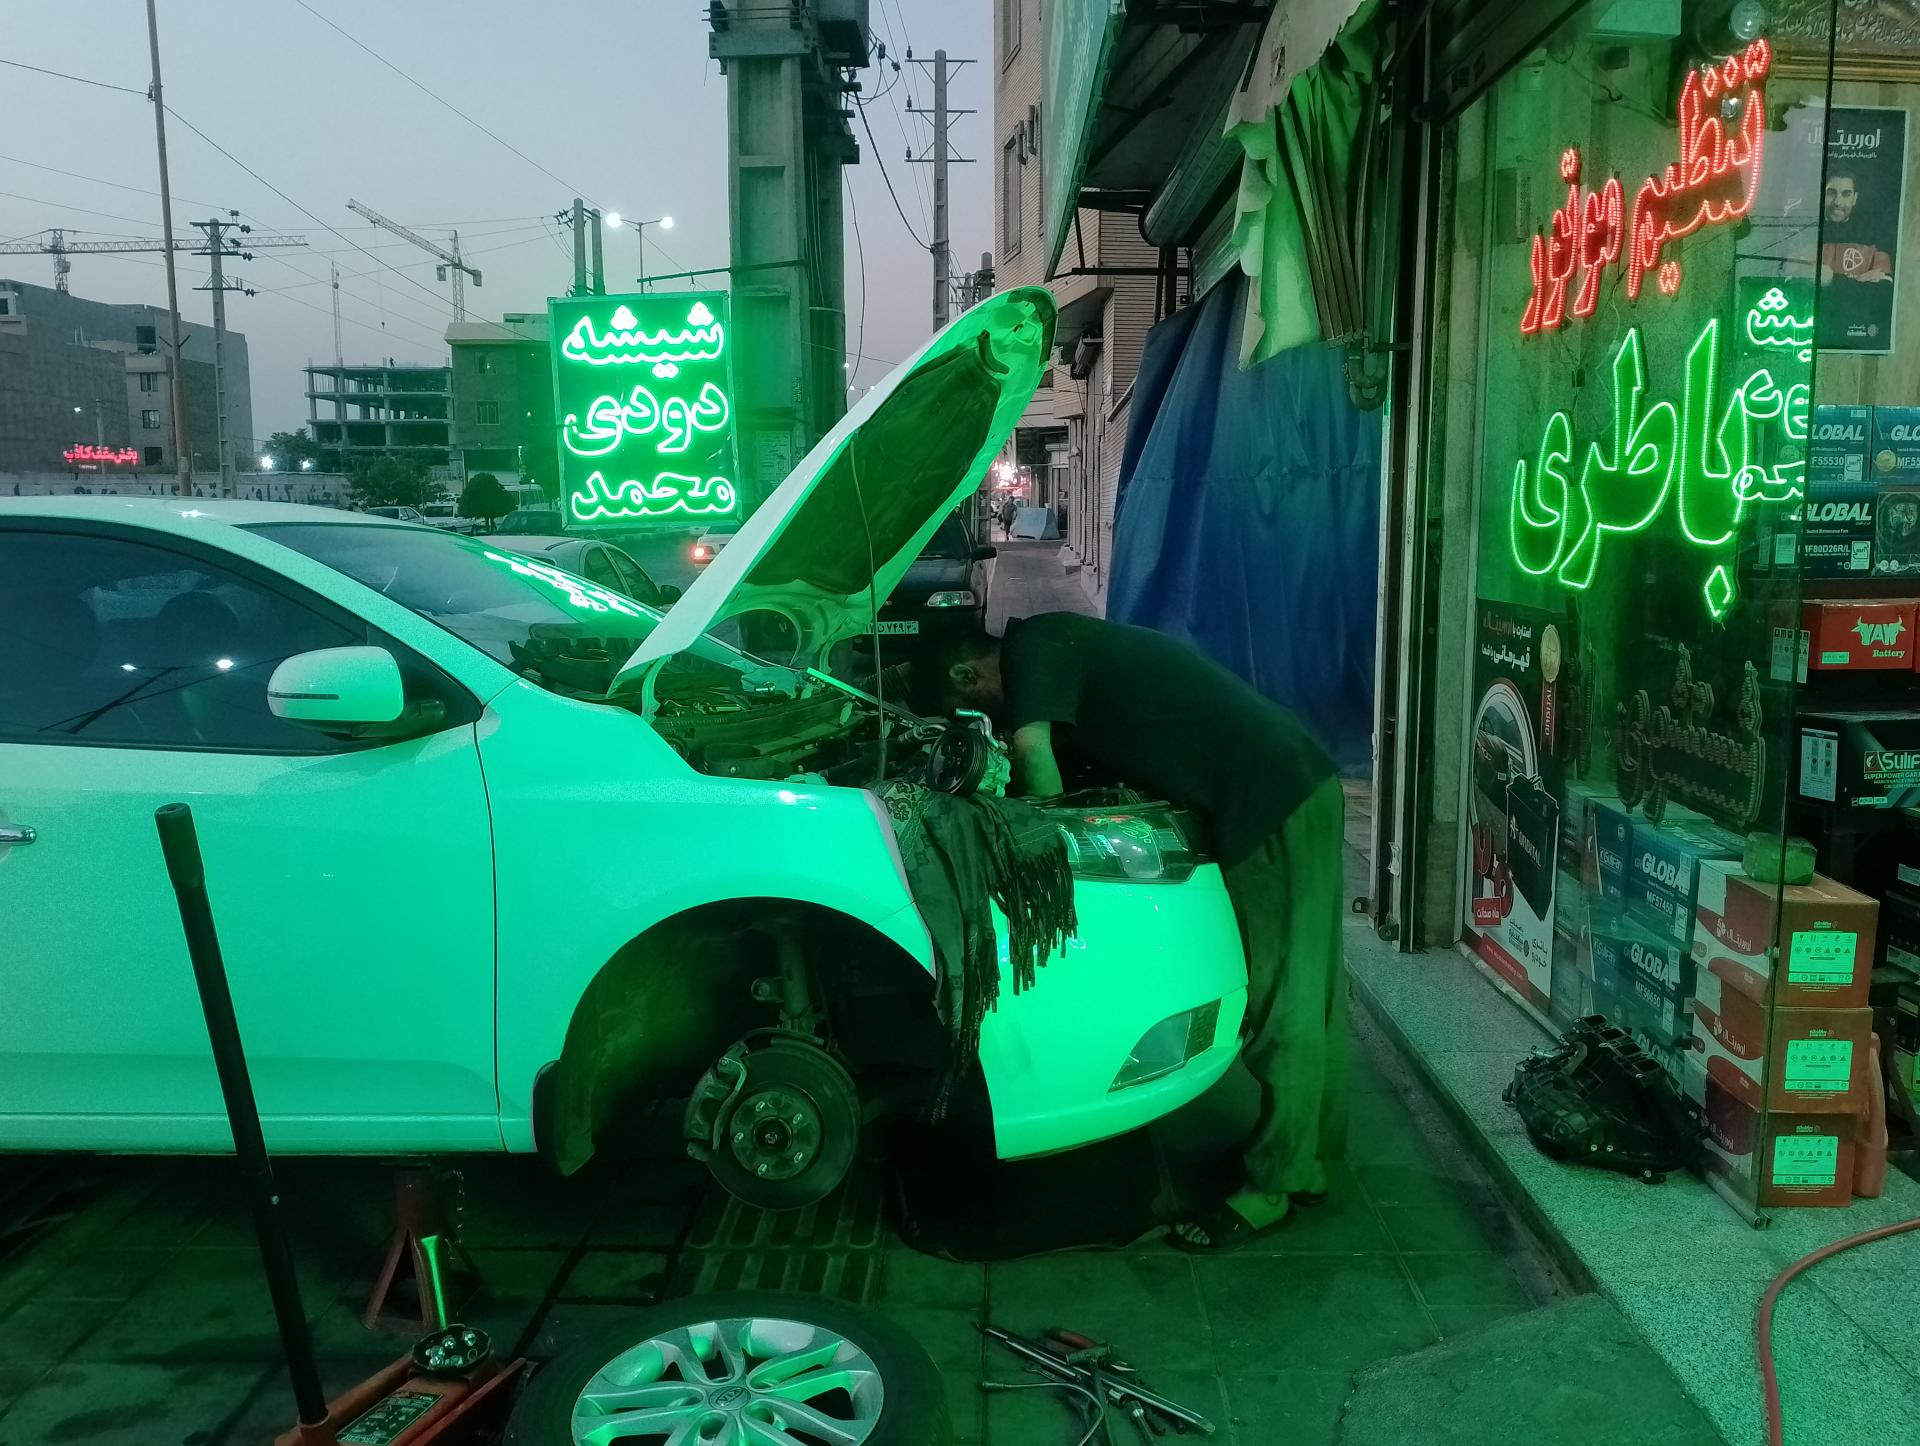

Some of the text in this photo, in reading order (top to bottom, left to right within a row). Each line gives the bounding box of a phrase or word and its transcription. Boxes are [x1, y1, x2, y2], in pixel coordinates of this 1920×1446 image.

[1808, 126, 1881, 149] اوربیتال
[1520, 147, 1624, 334] موتور
[562, 301, 725, 379] شیشه
[563, 381, 730, 456] دودی
[1811, 423, 1866, 441] LOBAL
[1510, 317, 1748, 618] باطری
[1811, 455, 1845, 466] F55530
[570, 470, 736, 520] محمد
[1494, 645, 1531, 672] قهرمانی
[1872, 649, 1905, 658] Battery
[1642, 852, 1689, 896] GLOBA
